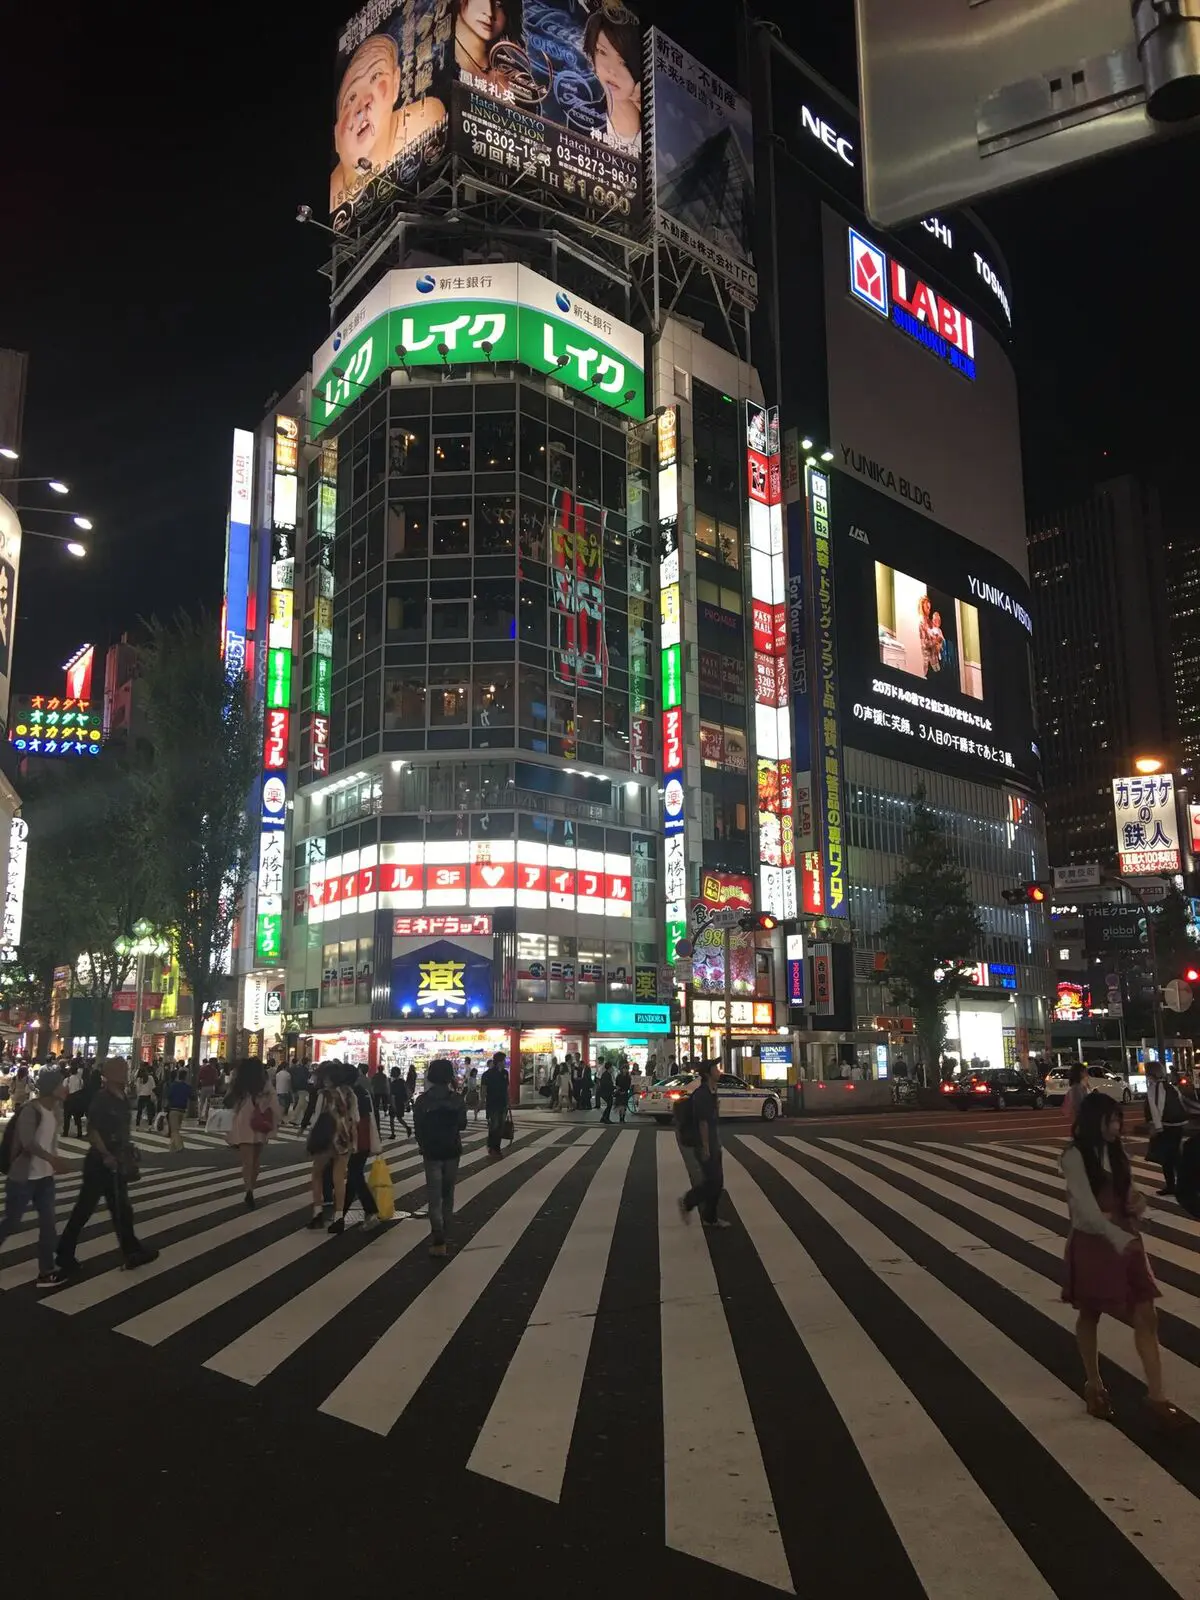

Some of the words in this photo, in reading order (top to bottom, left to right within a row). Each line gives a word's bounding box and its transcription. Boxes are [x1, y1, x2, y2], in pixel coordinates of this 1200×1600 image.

[657, 35, 683, 68] 新宿
[698, 67, 737, 110] 不動産
[470, 93, 499, 113] Hatch
[505, 108, 546, 133] TOKYO
[470, 104, 545, 143] INNOVATION
[462, 119, 551, 168] 03-6302-198
[801, 104, 854, 168] NEC
[559, 132, 591, 155] Hatch
[595, 147, 637, 175] TOKYO
[660, 214, 756, 288] 不動産は株式会社TFC
[439, 275, 493, 290] 新生銀行
[573, 303, 613, 336] 新生銀行
[891, 259, 975, 359] LABI
[402, 313, 506, 352] レイク
[543, 322, 625, 394] レイク
[325, 336, 374, 418] レイク
[841, 443, 897, 493] YUNIKA
[899, 478, 935, 514] BLDG.
[815, 501, 826, 514] B1
[816, 522, 827, 535] B2
[790, 575, 800, 598] For
[790, 598, 803, 633] Your
[967, 573, 1012, 615] YUNIKA
[1012, 599, 1034, 637] VISION
[777, 656, 788, 707] まつげ本舗
[30, 709, 89, 726] オカダヤ
[31, 695, 89, 712] オカダヤ
[28, 738, 87, 755] オカダヤ
[29, 724, 88, 741] オカダヤ
[269, 711, 285, 766] アイフル
[666, 711, 681, 768] アイフル
[1115, 778, 1173, 809] カラオケ
[803, 803, 811, 836] LABI
[1138, 806, 1153, 823] の
[1123, 821, 1173, 850] 鉄人
[261, 835, 283, 892] 大勝軒
[667, 839, 685, 897] 大勝軒
[1122, 862, 1179, 873] 03-3345-6430
[329, 868, 414, 901] アイフル
[436, 869, 460, 885] 3F
[524, 867, 626, 898] アイフル
[263, 917, 275, 951] レイク
[395, 915, 492, 935] ミネドラッグ
[1102, 925, 1136, 940] global
[416, 960, 467, 1006] 薬
[635, 971, 656, 998] 薬
[793, 962, 802, 996] PROMISE
[637, 1014, 665, 1022] PANDORA
